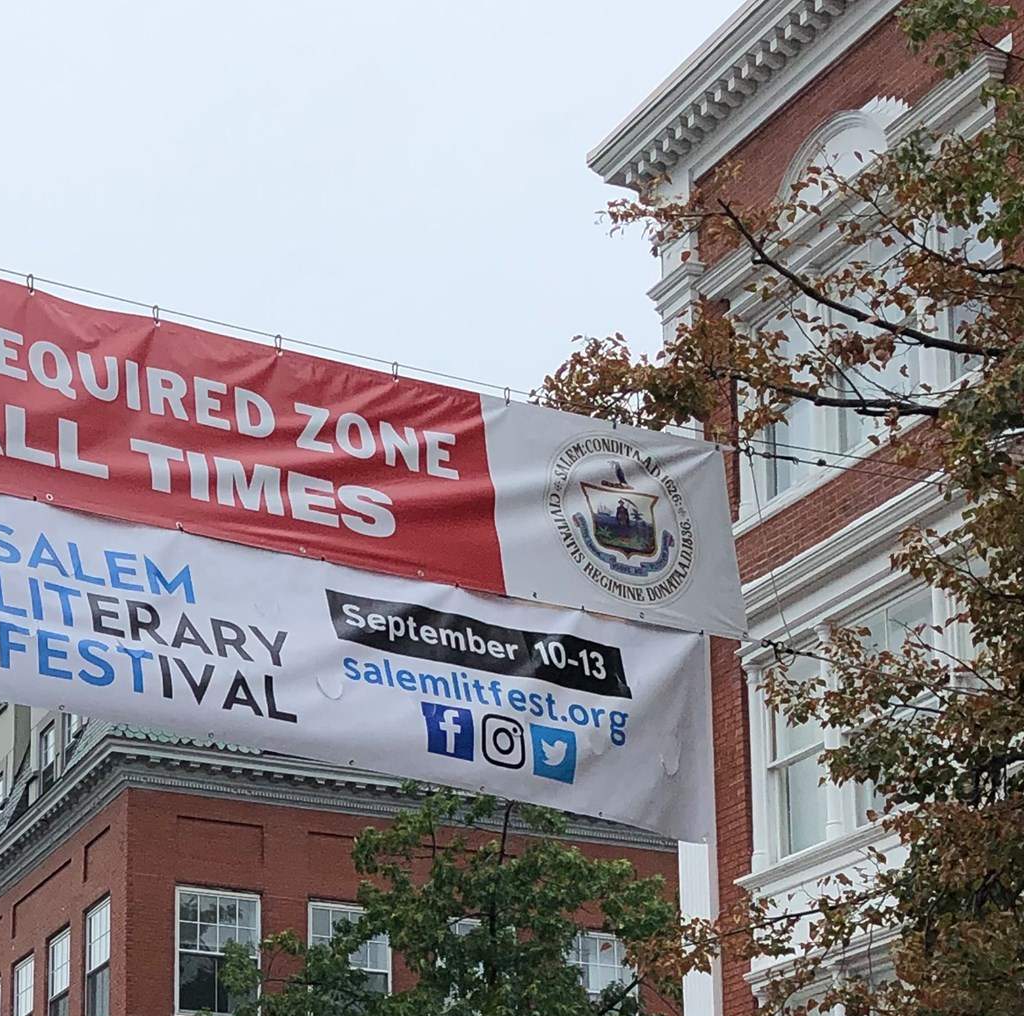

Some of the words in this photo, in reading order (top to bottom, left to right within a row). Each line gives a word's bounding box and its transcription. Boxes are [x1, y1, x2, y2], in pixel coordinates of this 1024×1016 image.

[294, 402, 460, 481] ZONE
[129, 437, 397, 539] TIMES
[583, 561, 645, 602] REGIMINE
[341, 603, 519, 661] September
[534, 641, 608, 681] 10-13
[343, 656, 629, 747] salemlitfest.org
